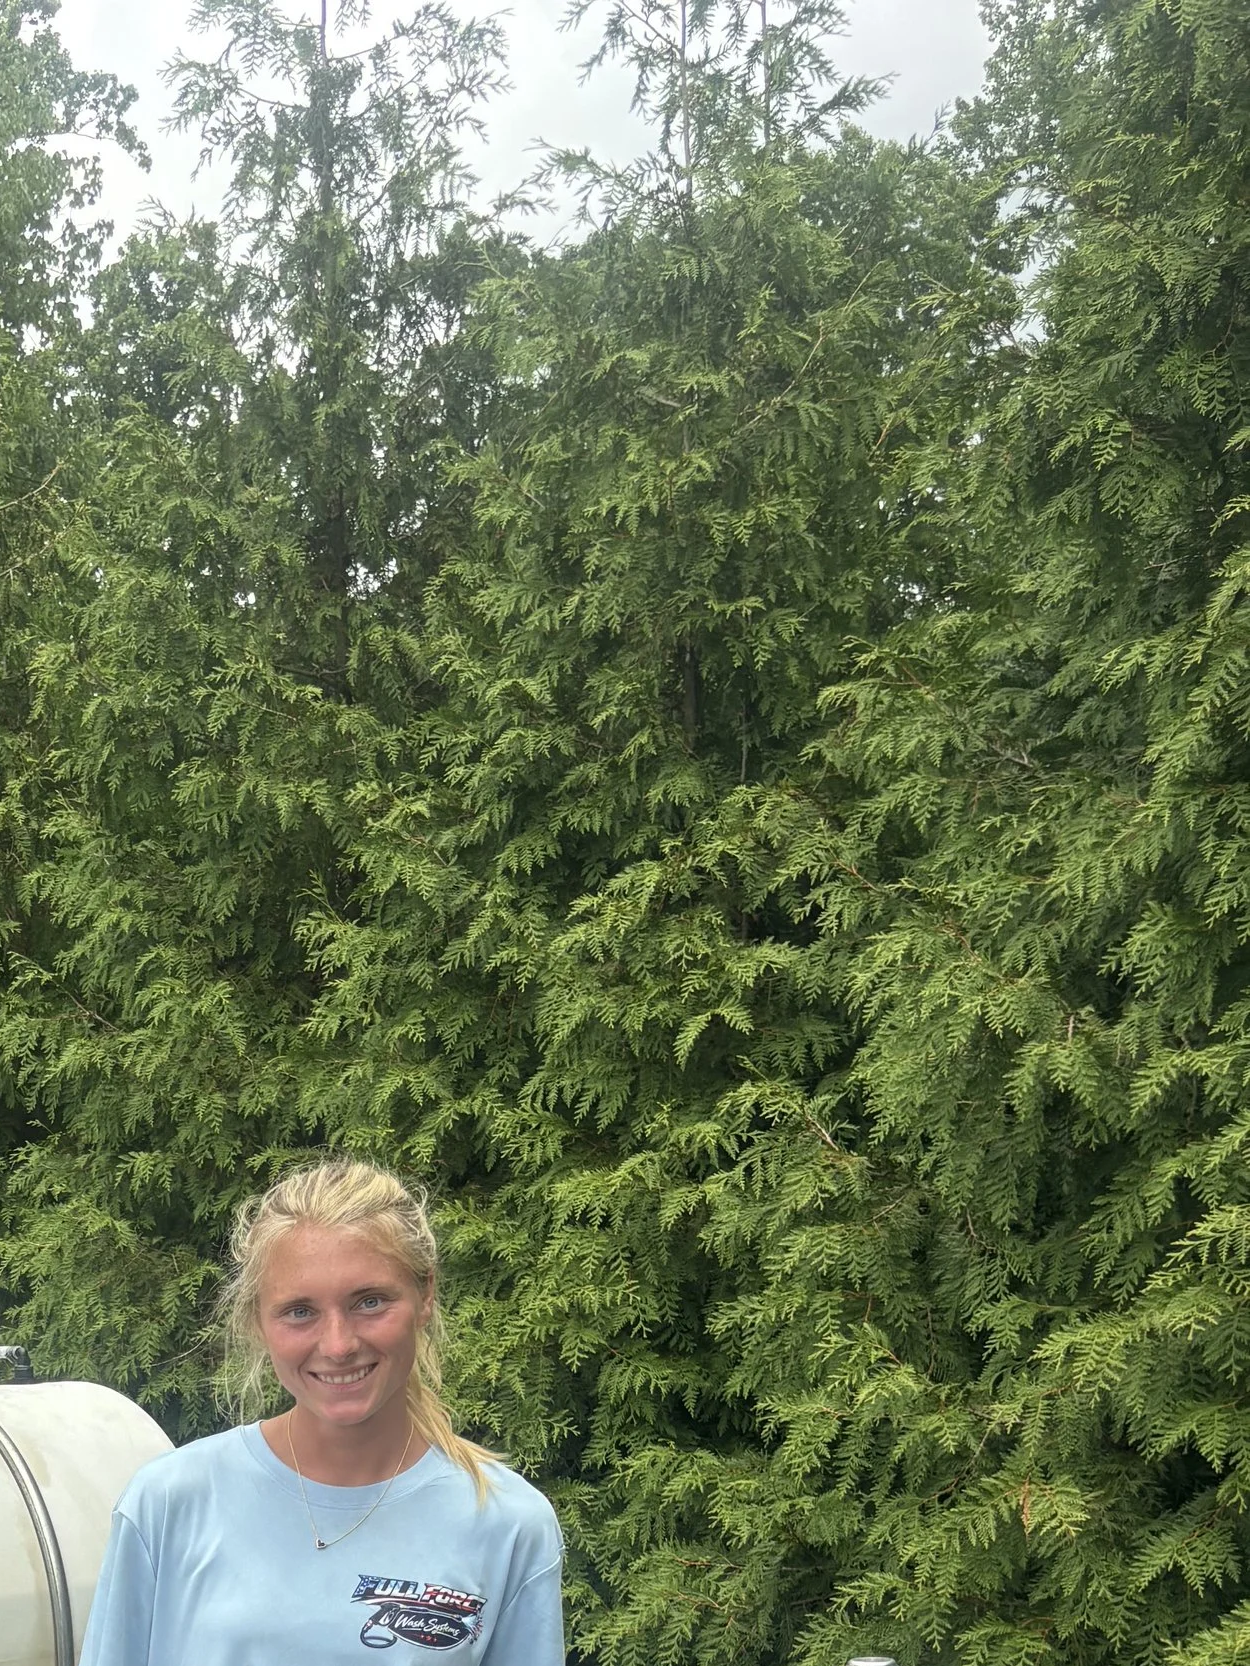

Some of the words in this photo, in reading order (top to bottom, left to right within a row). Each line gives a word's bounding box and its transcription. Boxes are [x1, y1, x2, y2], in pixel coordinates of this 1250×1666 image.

[352, 1575, 420, 1600] FULL
[420, 1583, 488, 1609] FORC
[394, 1613, 426, 1629] Wash
[423, 1618, 461, 1637] Systems
